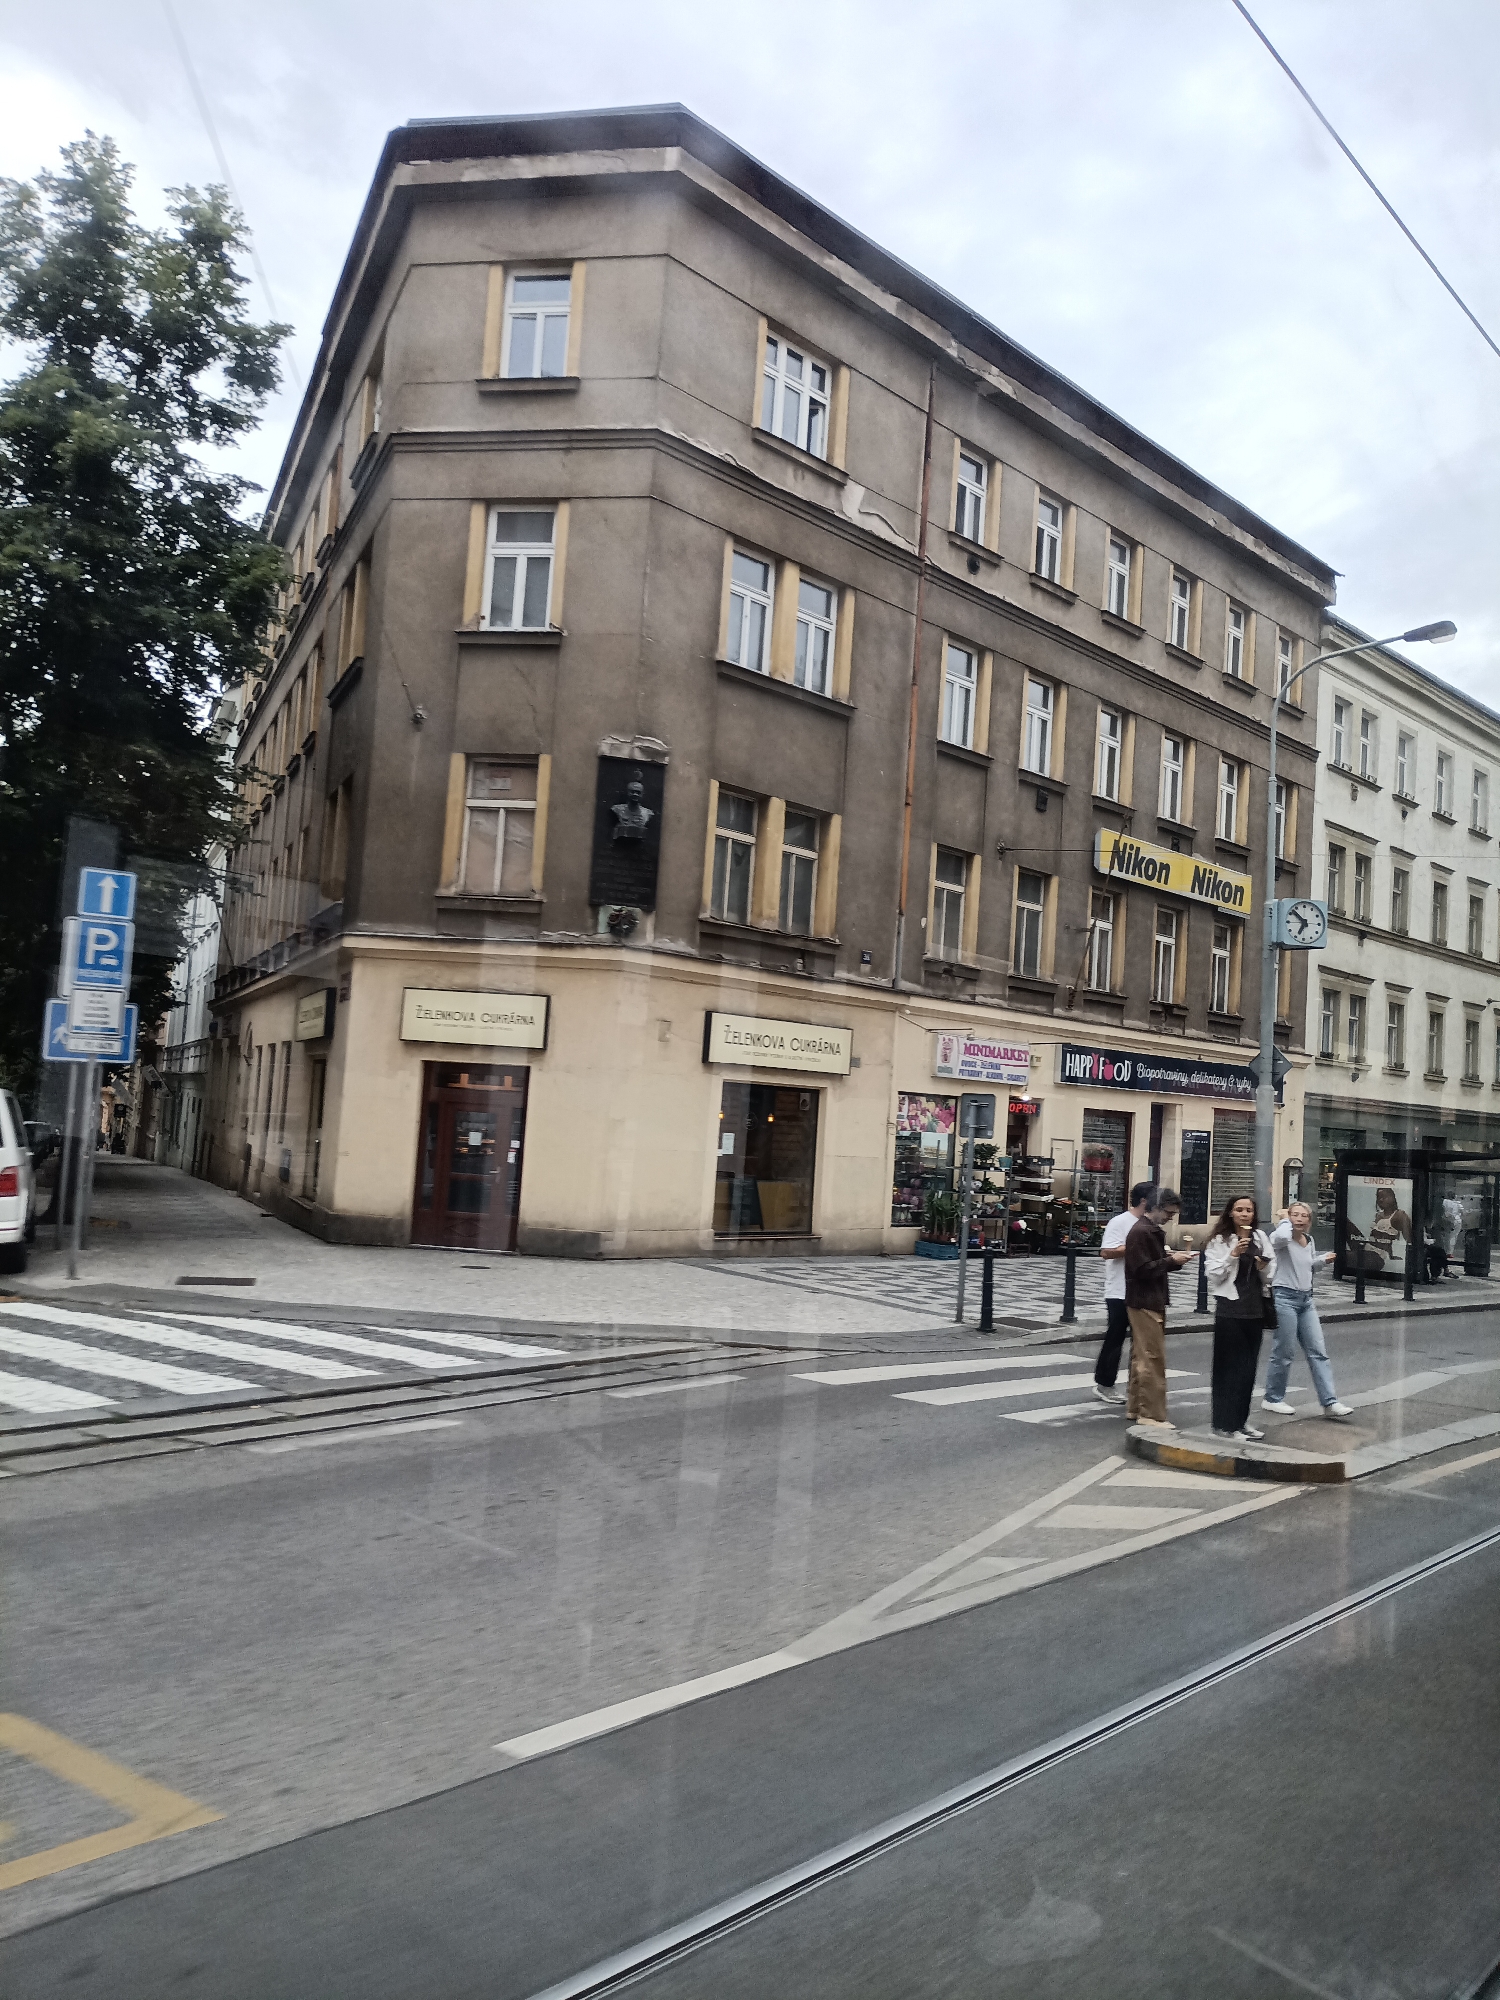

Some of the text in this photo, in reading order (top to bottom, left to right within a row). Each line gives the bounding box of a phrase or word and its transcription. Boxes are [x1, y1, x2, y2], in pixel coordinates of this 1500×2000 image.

[1110, 839, 1245, 907] Nikon Nikon
[84, 927, 119, 965] P
[480, 1012, 536, 1026] CUKRÁRNA
[723, 1024, 842, 1056] ŽELENKOVA CUKRÁRNA
[963, 1043, 1030, 1062] MINIMARKET
[1136, 1062, 1189, 1087] Biopotraviny,
[1191, 1070, 1228, 1091] delikatesy
[1236, 1077, 1252, 1094] ryby
[1009, 1103, 1037, 1114] OPEN
[1363, 1177, 1396, 1186] LINDEX
